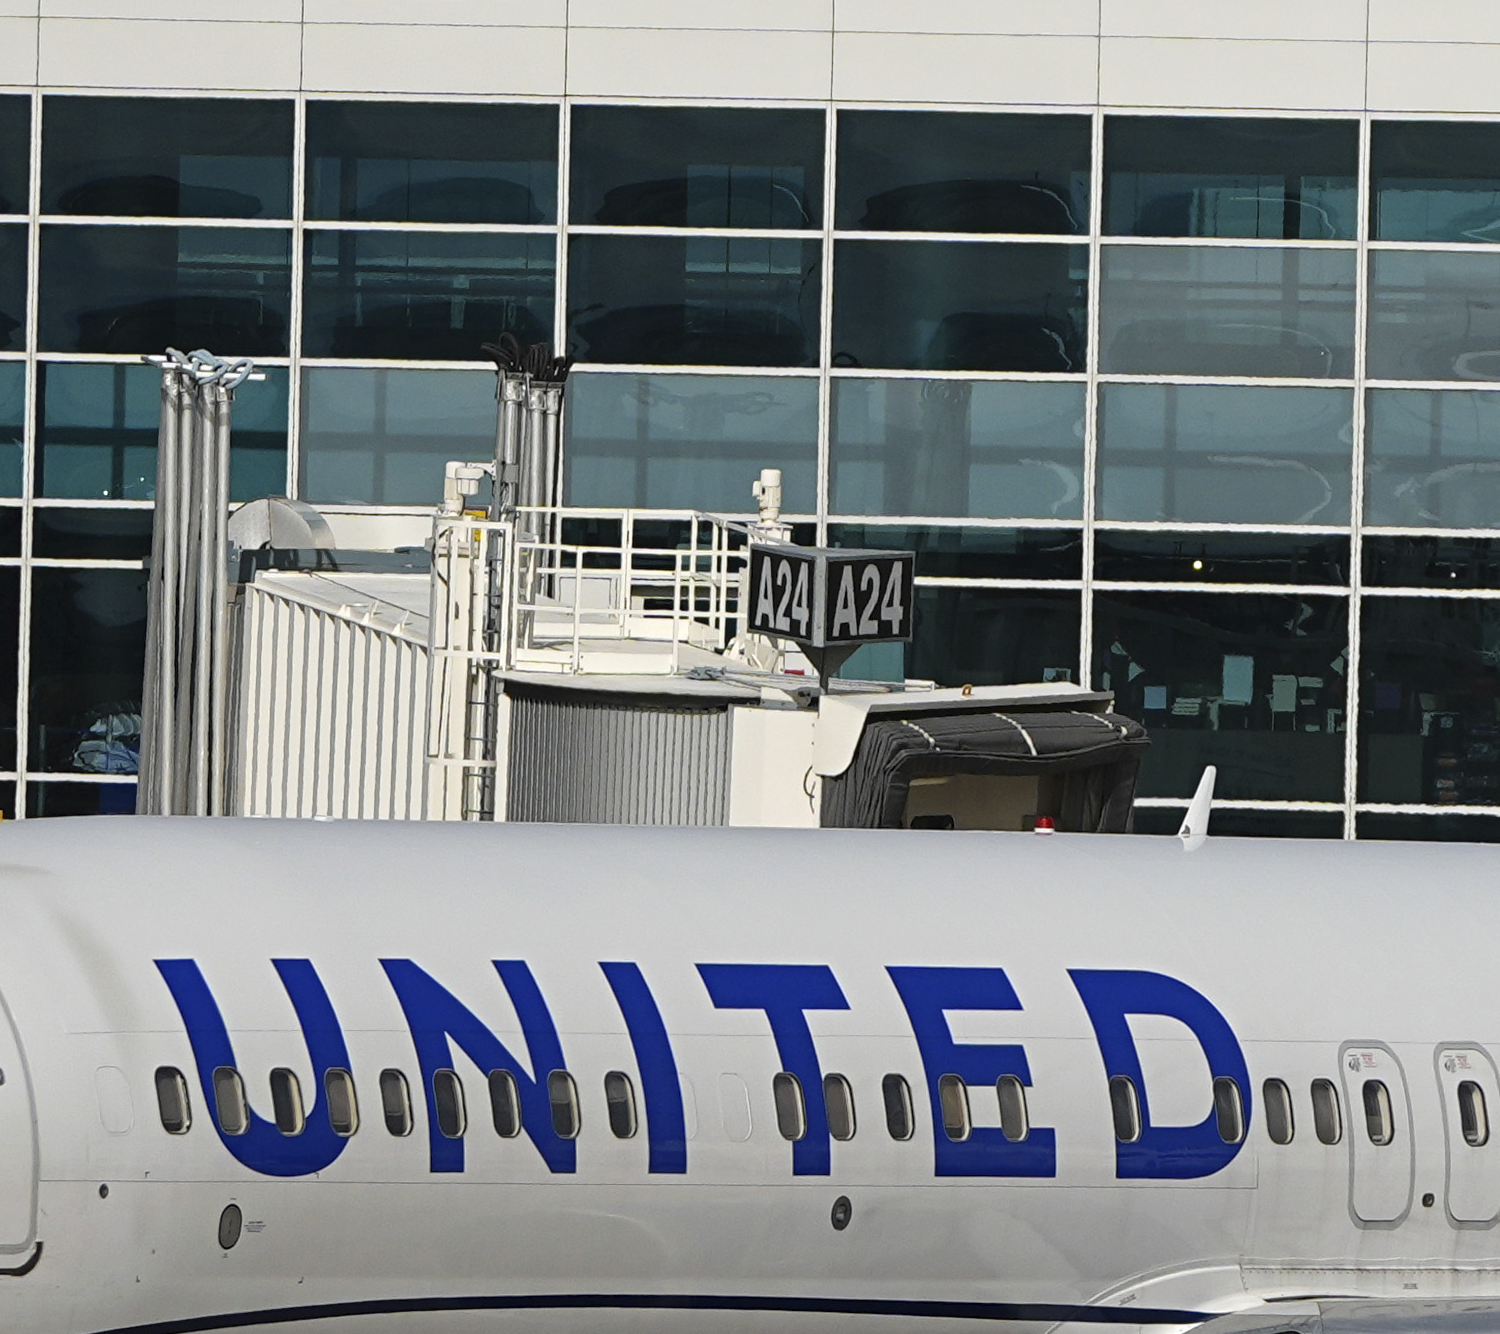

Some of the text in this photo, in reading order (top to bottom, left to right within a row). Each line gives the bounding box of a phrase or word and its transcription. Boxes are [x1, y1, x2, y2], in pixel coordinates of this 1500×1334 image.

[755, 556, 809, 636] A24
[832, 561, 903, 637] A24
[152, 958, 1253, 1179] UNITED
